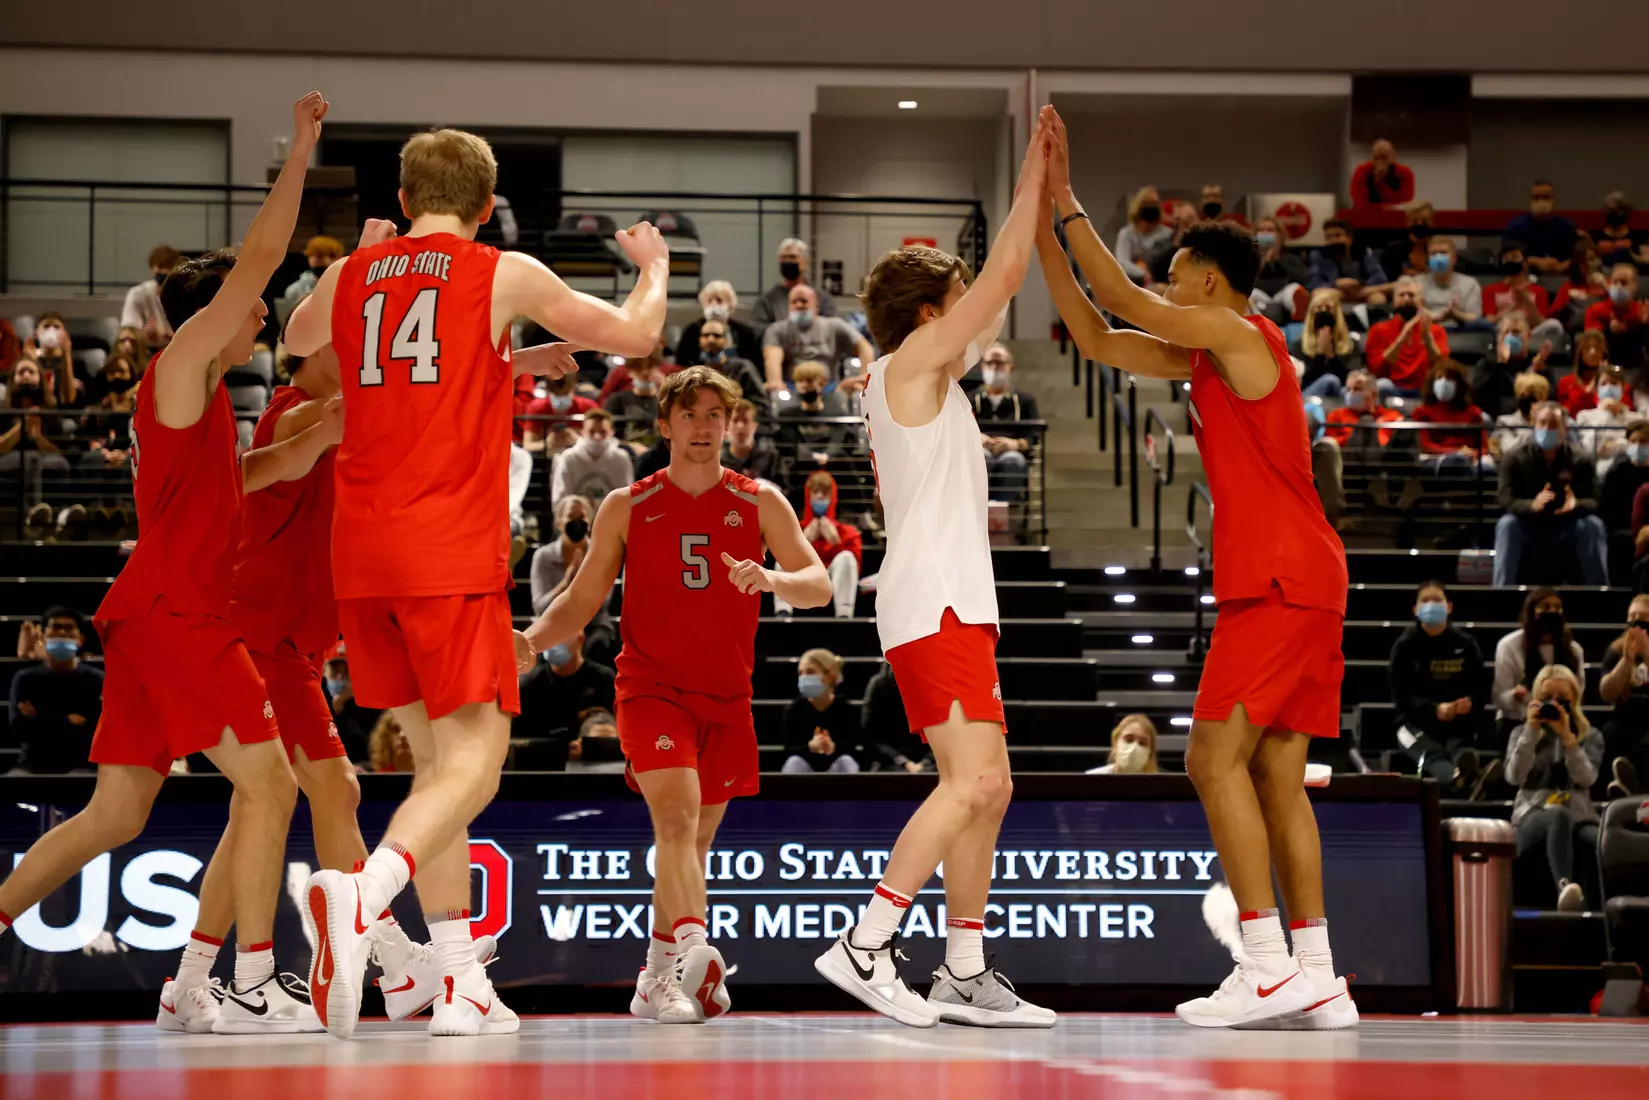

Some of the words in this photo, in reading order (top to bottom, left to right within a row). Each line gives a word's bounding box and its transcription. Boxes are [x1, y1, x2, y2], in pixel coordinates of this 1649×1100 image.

[365, 254, 410, 286] OHIO
[410, 250, 452, 282] STATE
[359, 287, 440, 388] 14
[680, 533, 711, 590] 5
[536, 843, 631, 880] THE
[645, 844, 765, 881] IO
[779, 842, 890, 881] STAT
[935, 850, 1218, 881] IVERSITY
[539, 904, 739, 939] WEXR
[754, 904, 947, 939] MEDAL
[981, 903, 1155, 939] CENTER
